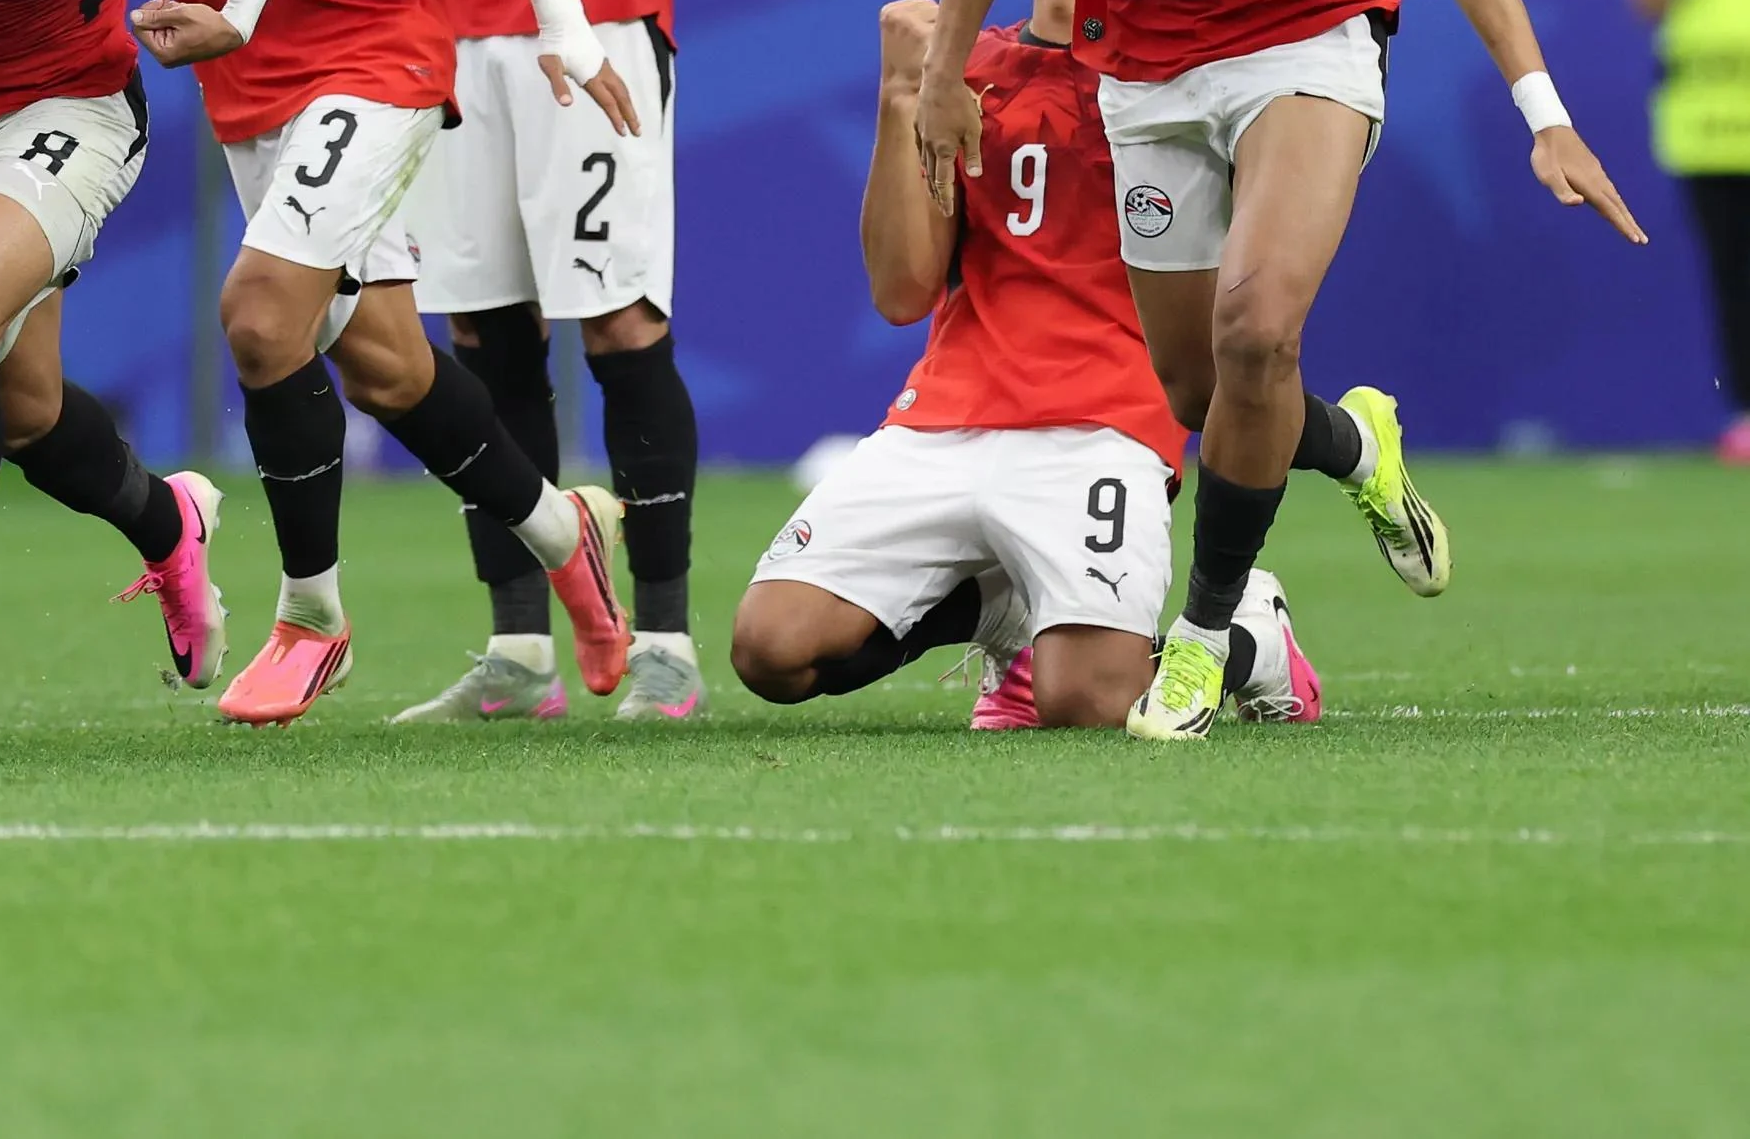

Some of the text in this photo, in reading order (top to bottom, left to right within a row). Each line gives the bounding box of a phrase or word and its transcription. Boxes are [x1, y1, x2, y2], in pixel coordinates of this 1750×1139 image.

[18, 130, 80, 177] 8
[295, 108, 358, 188] 3
[574, 152, 616, 242] 2
[1006, 143, 1048, 237] 9
[1085, 477, 1127, 553] 9
